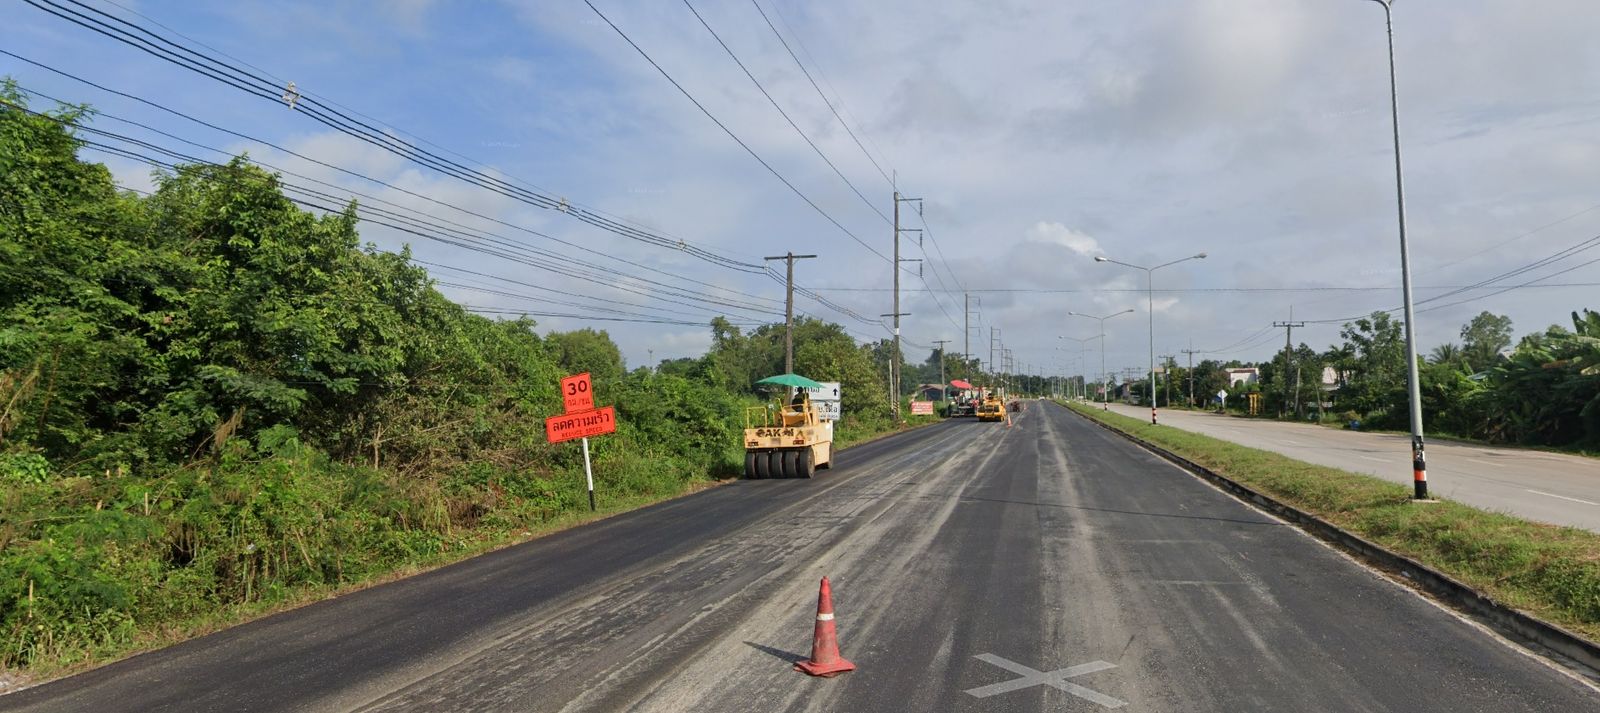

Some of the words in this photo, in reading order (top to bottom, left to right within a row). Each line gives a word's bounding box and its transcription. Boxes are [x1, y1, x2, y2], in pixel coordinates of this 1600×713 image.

[568, 380, 588, 395] 30
[553, 411, 609, 431] ลดความเร็ว
